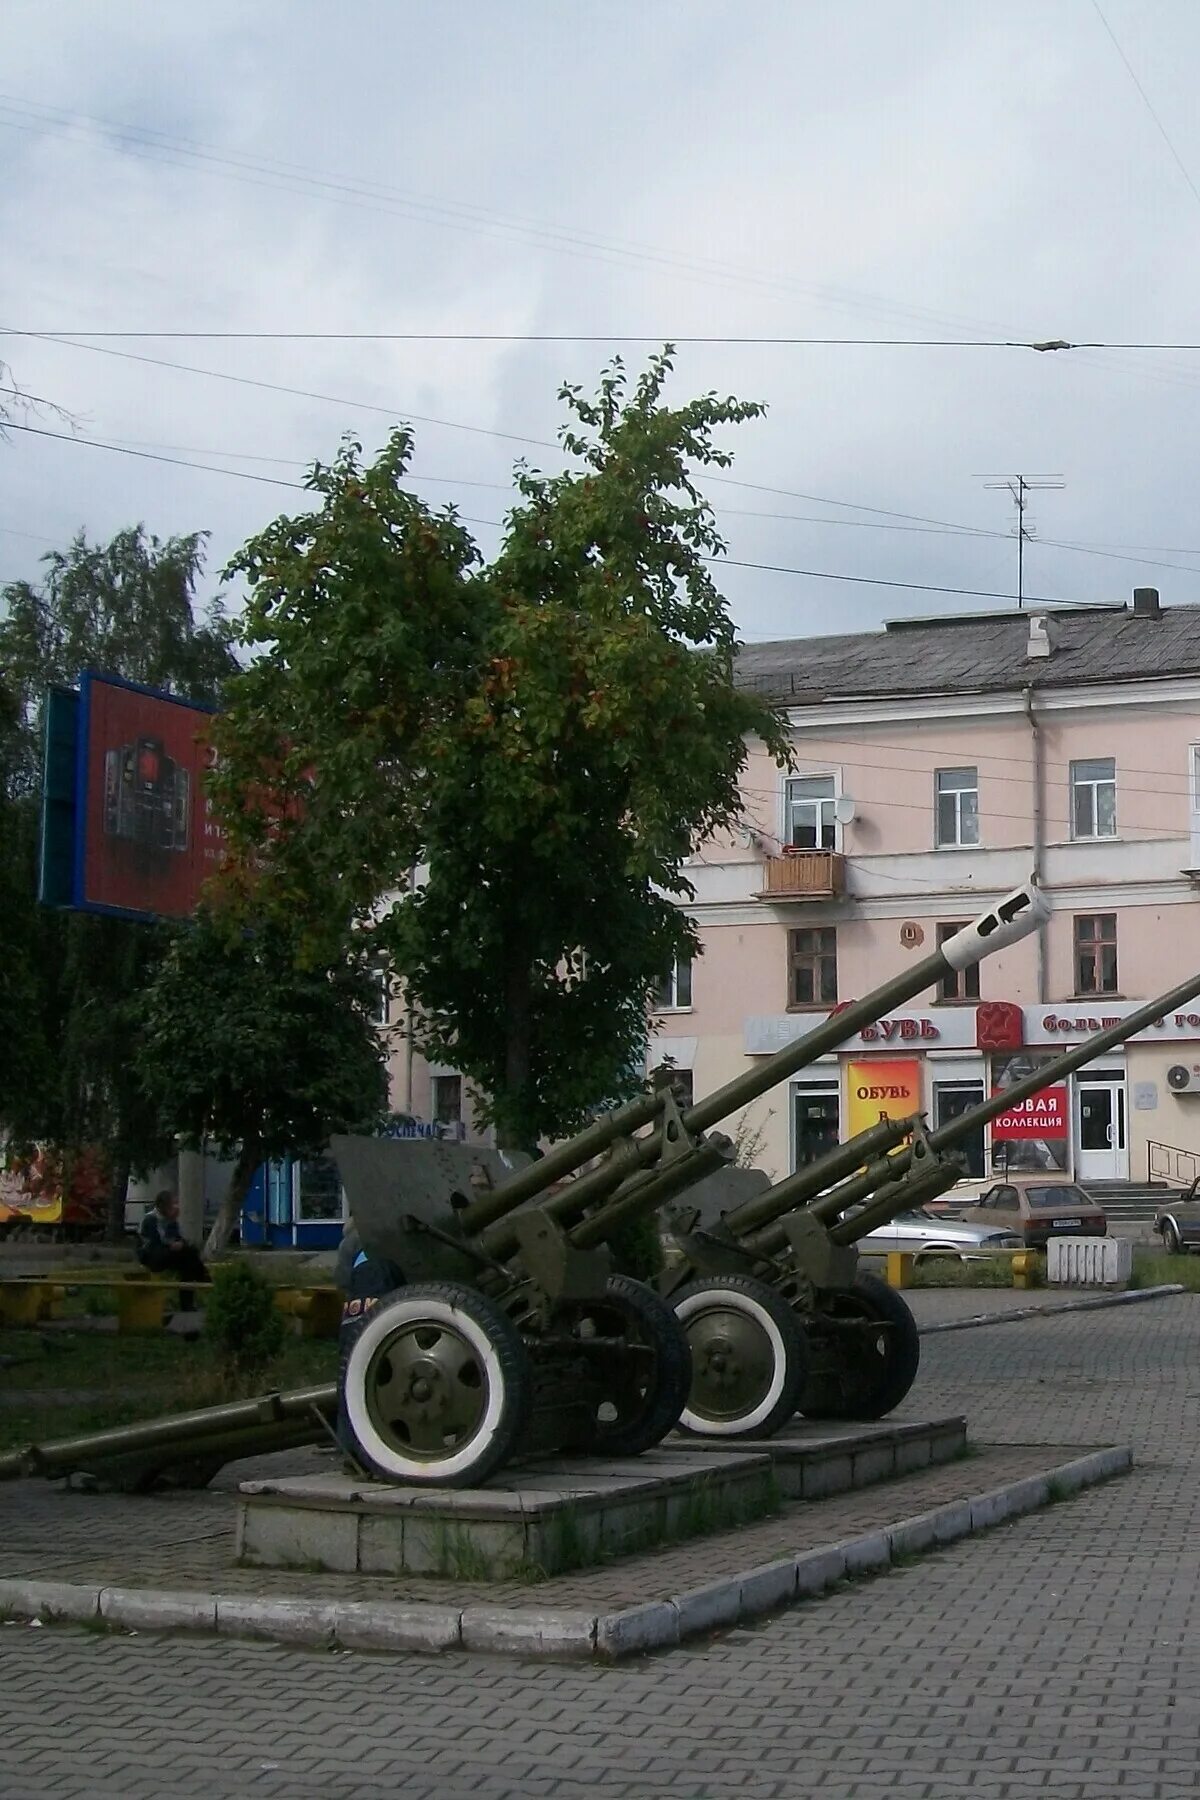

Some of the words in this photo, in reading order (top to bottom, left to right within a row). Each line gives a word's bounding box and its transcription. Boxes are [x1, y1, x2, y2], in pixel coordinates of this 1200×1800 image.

[857, 1086, 911, 1100] ОБУВЬ
[1008, 1098, 1057, 1113] ОВАЯ
[995, 1116, 1062, 1128] КОЛЛЕКЦИЯ
